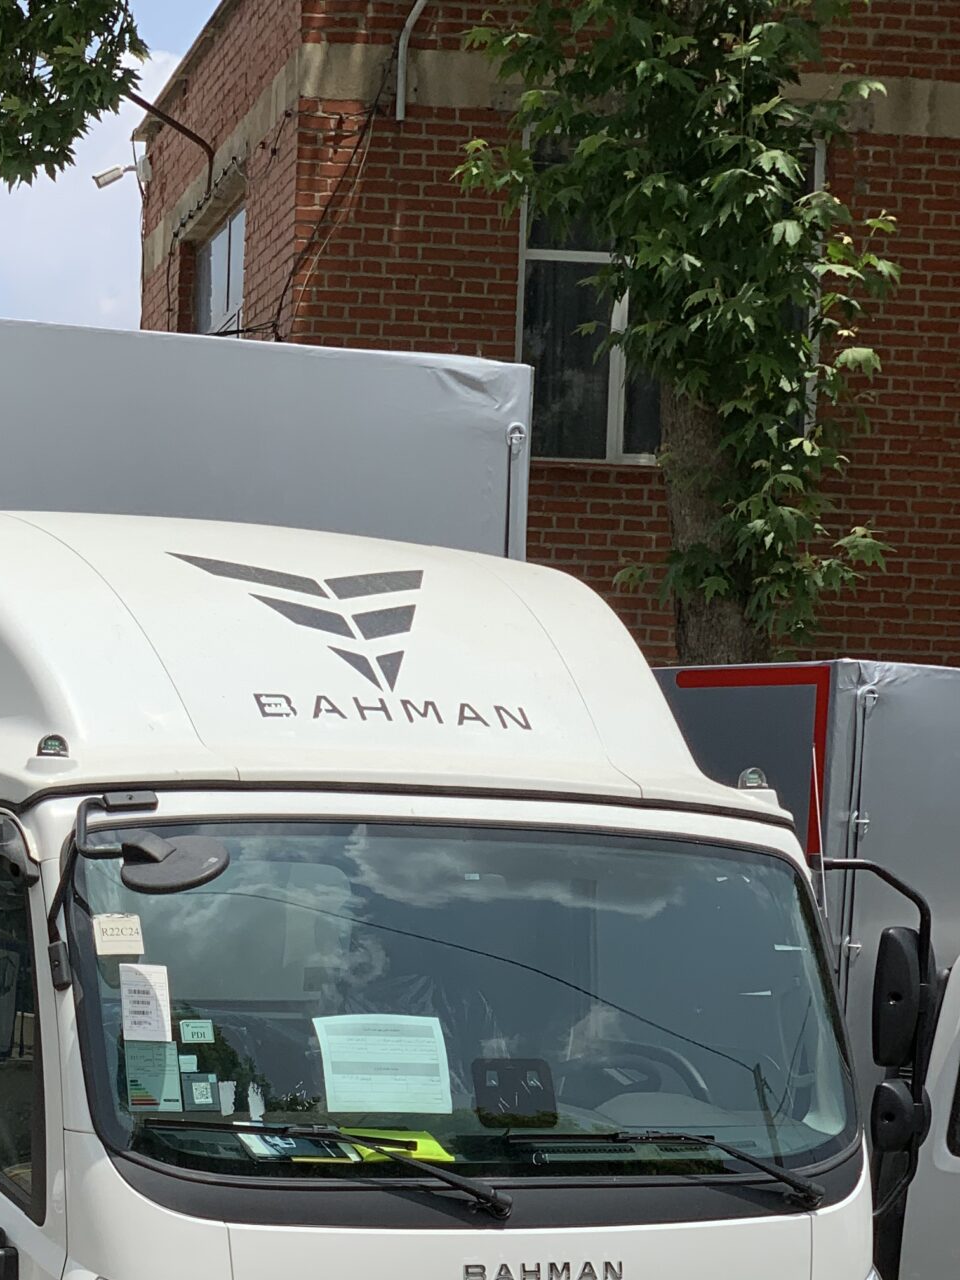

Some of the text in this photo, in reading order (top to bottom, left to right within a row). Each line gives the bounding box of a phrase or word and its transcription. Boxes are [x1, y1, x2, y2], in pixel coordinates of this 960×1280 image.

[252, 692, 533, 731] BAHMAN
[100, 926, 141, 938] R22C24
[191, 1031, 206, 1039] PDI
